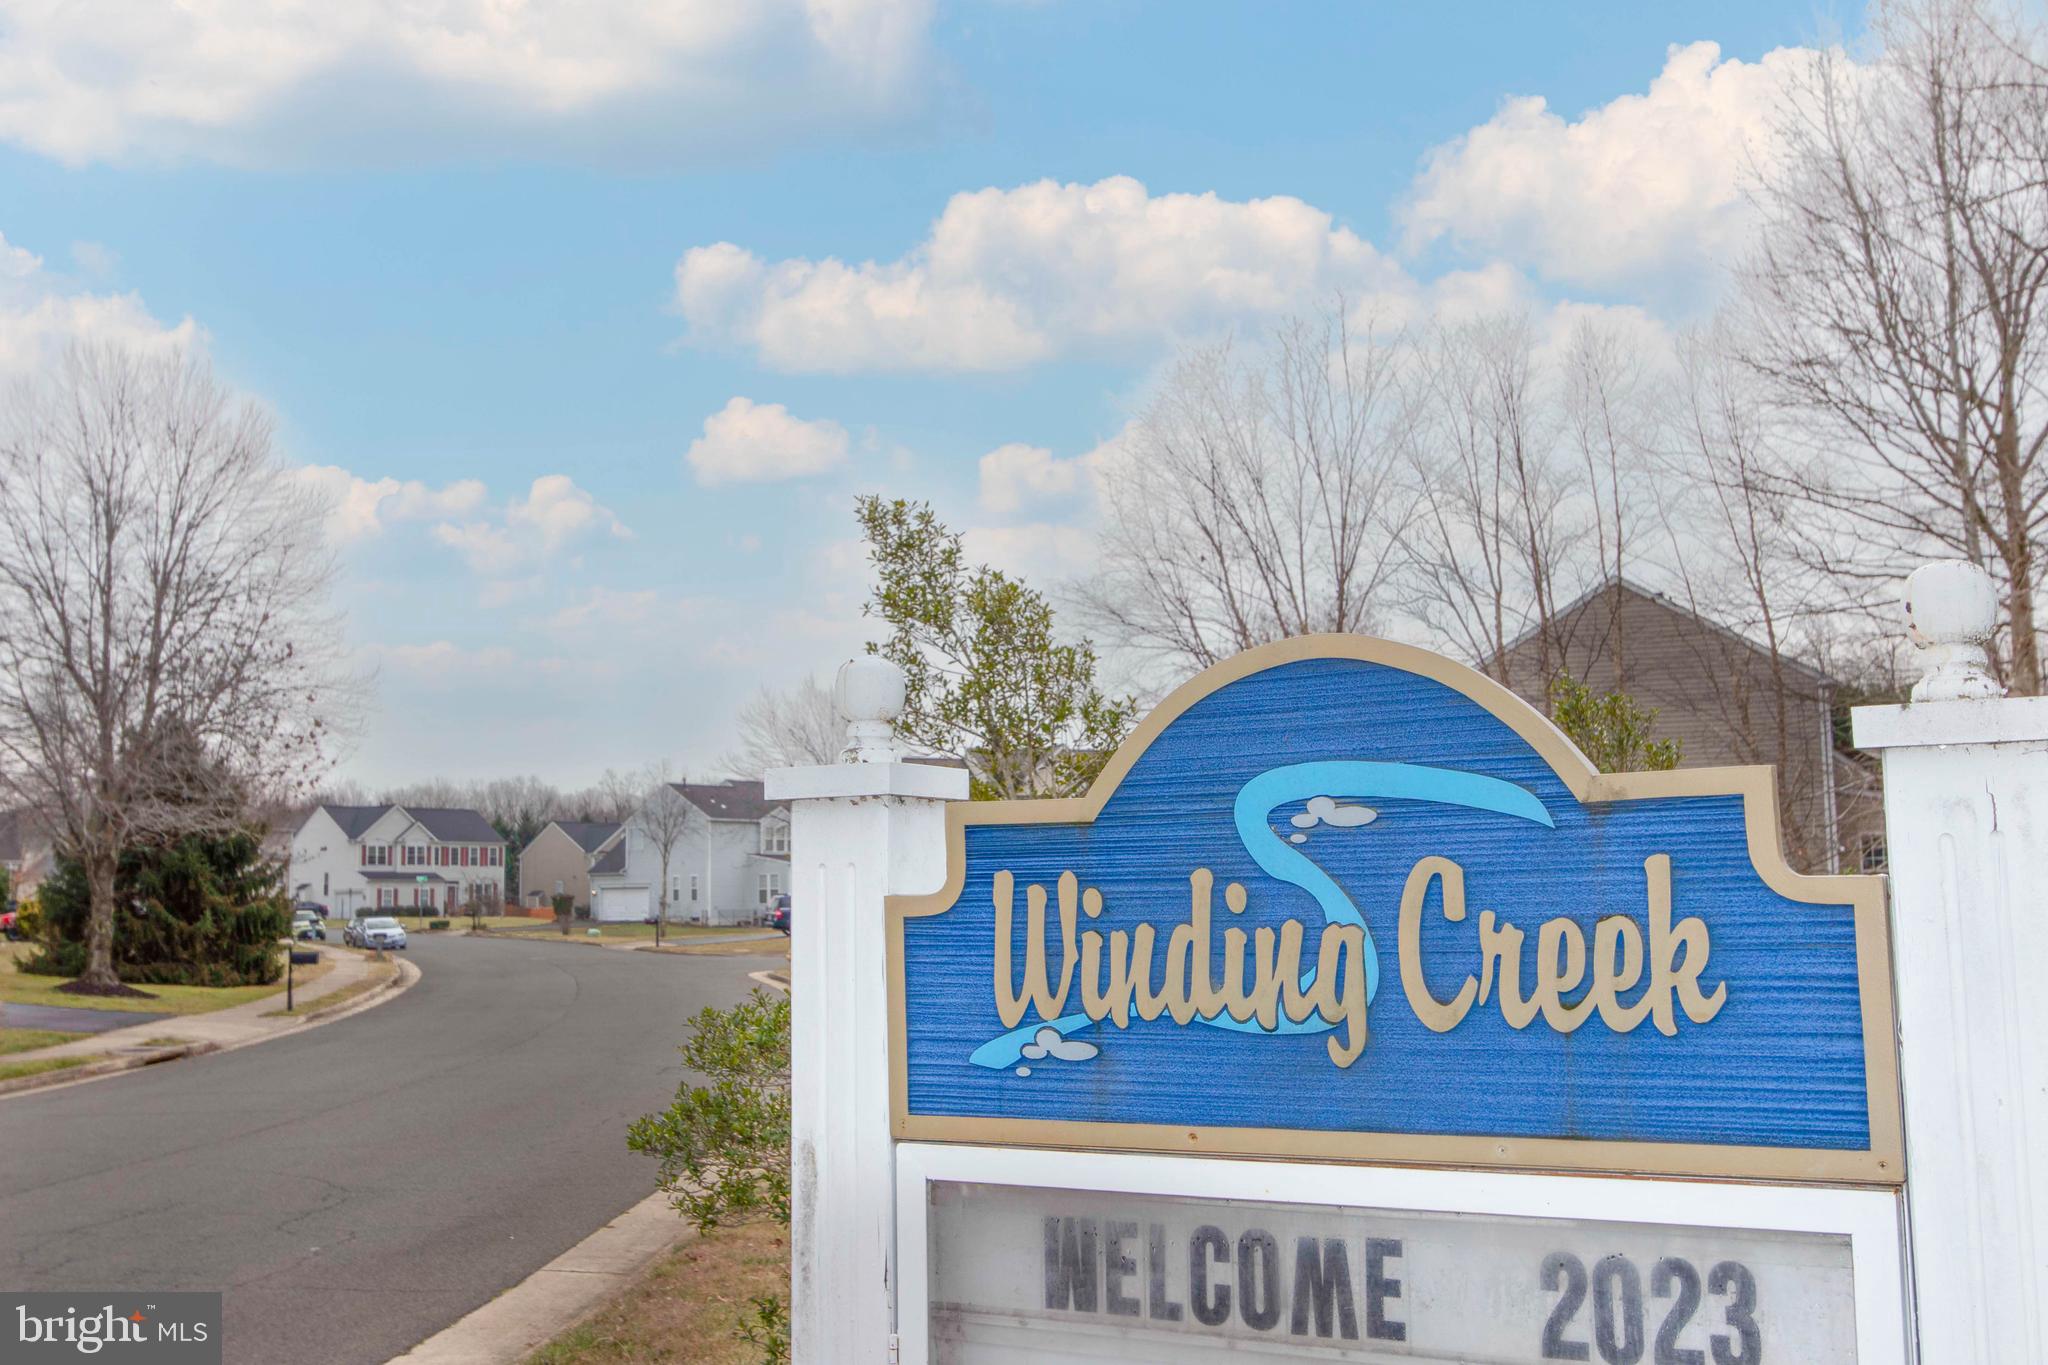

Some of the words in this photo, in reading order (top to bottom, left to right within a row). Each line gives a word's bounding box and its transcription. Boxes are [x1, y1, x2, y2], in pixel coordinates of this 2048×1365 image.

[993, 868, 1367, 1067] Winding
[1399, 854, 1727, 1037] Creek
[1044, 1216, 1408, 1342] WELCOME
[1540, 1251, 1762, 1365] 2023
